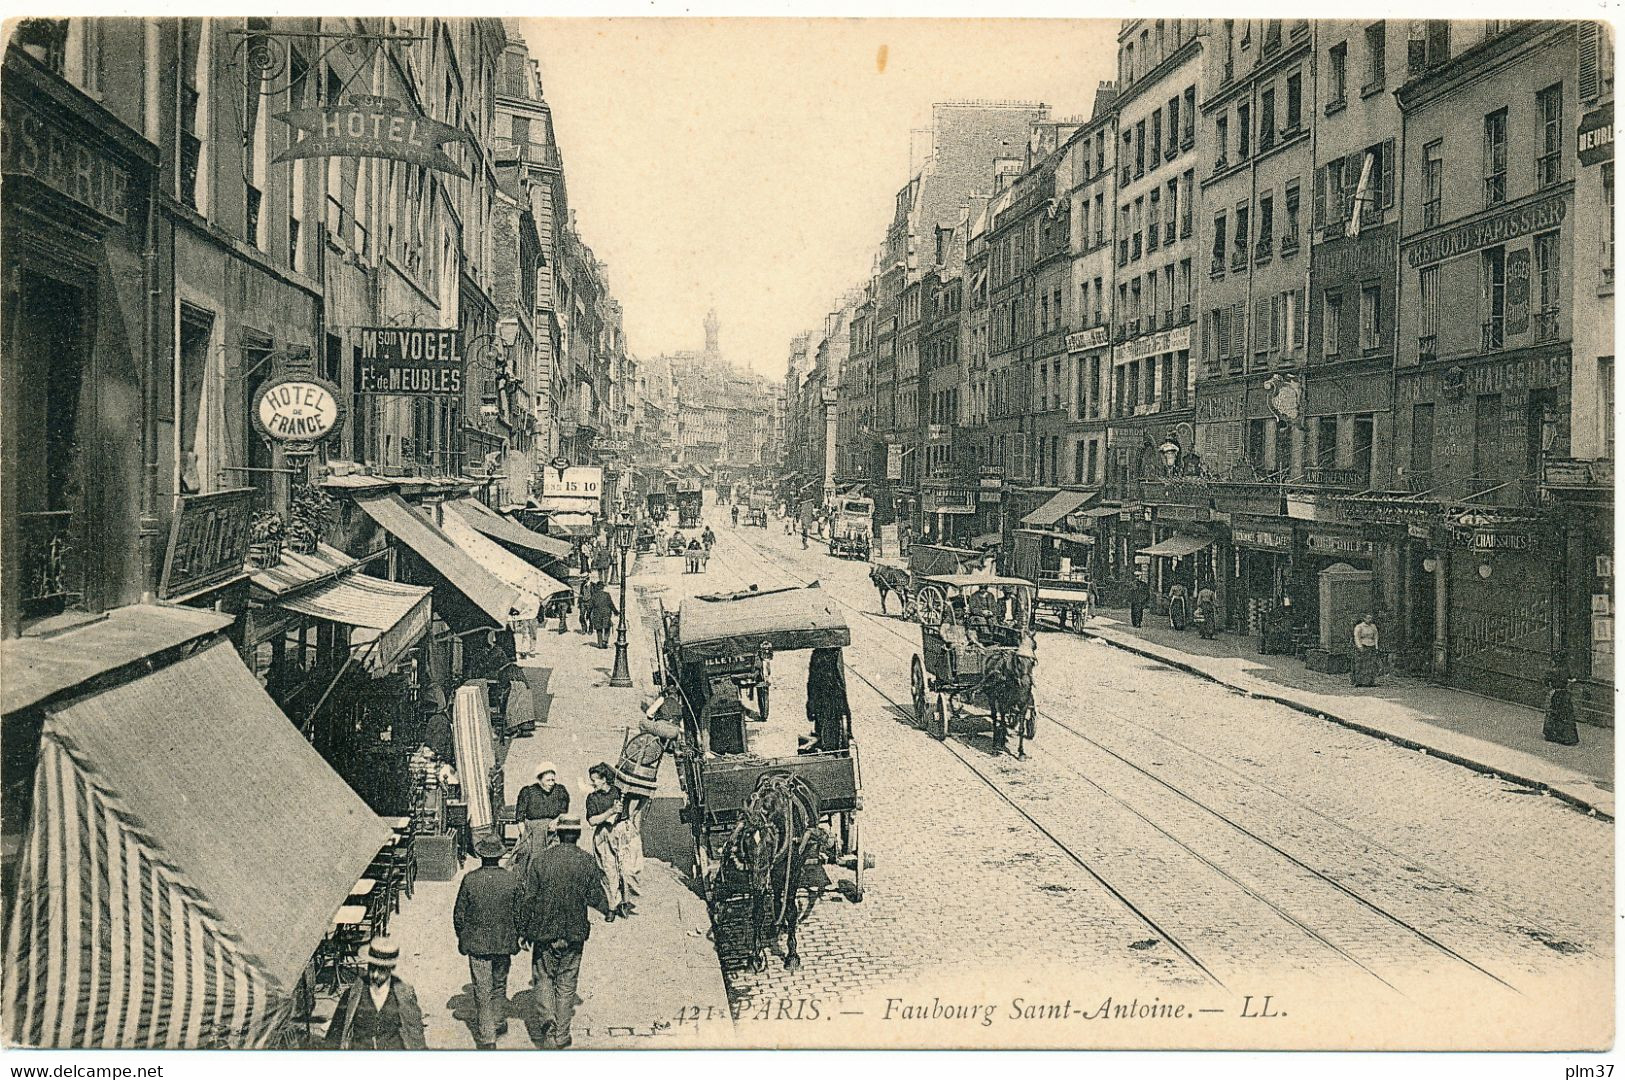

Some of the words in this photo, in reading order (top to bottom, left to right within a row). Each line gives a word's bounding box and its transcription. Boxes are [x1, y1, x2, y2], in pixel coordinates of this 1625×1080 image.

[344, 142, 433, 165] FRANCE
[1474, 204, 1562, 246] TAPISSIER
[399, 331, 462, 362] VOGEL
[389, 367, 461, 392] MEUBLES
[265, 385, 324, 413] HOTEL
[268, 412, 327, 436] FRANCE
[292, 408, 303, 416] DE
[583, 482, 597, 493] 10
[1474, 533, 1527, 549] CHAUSSURES
